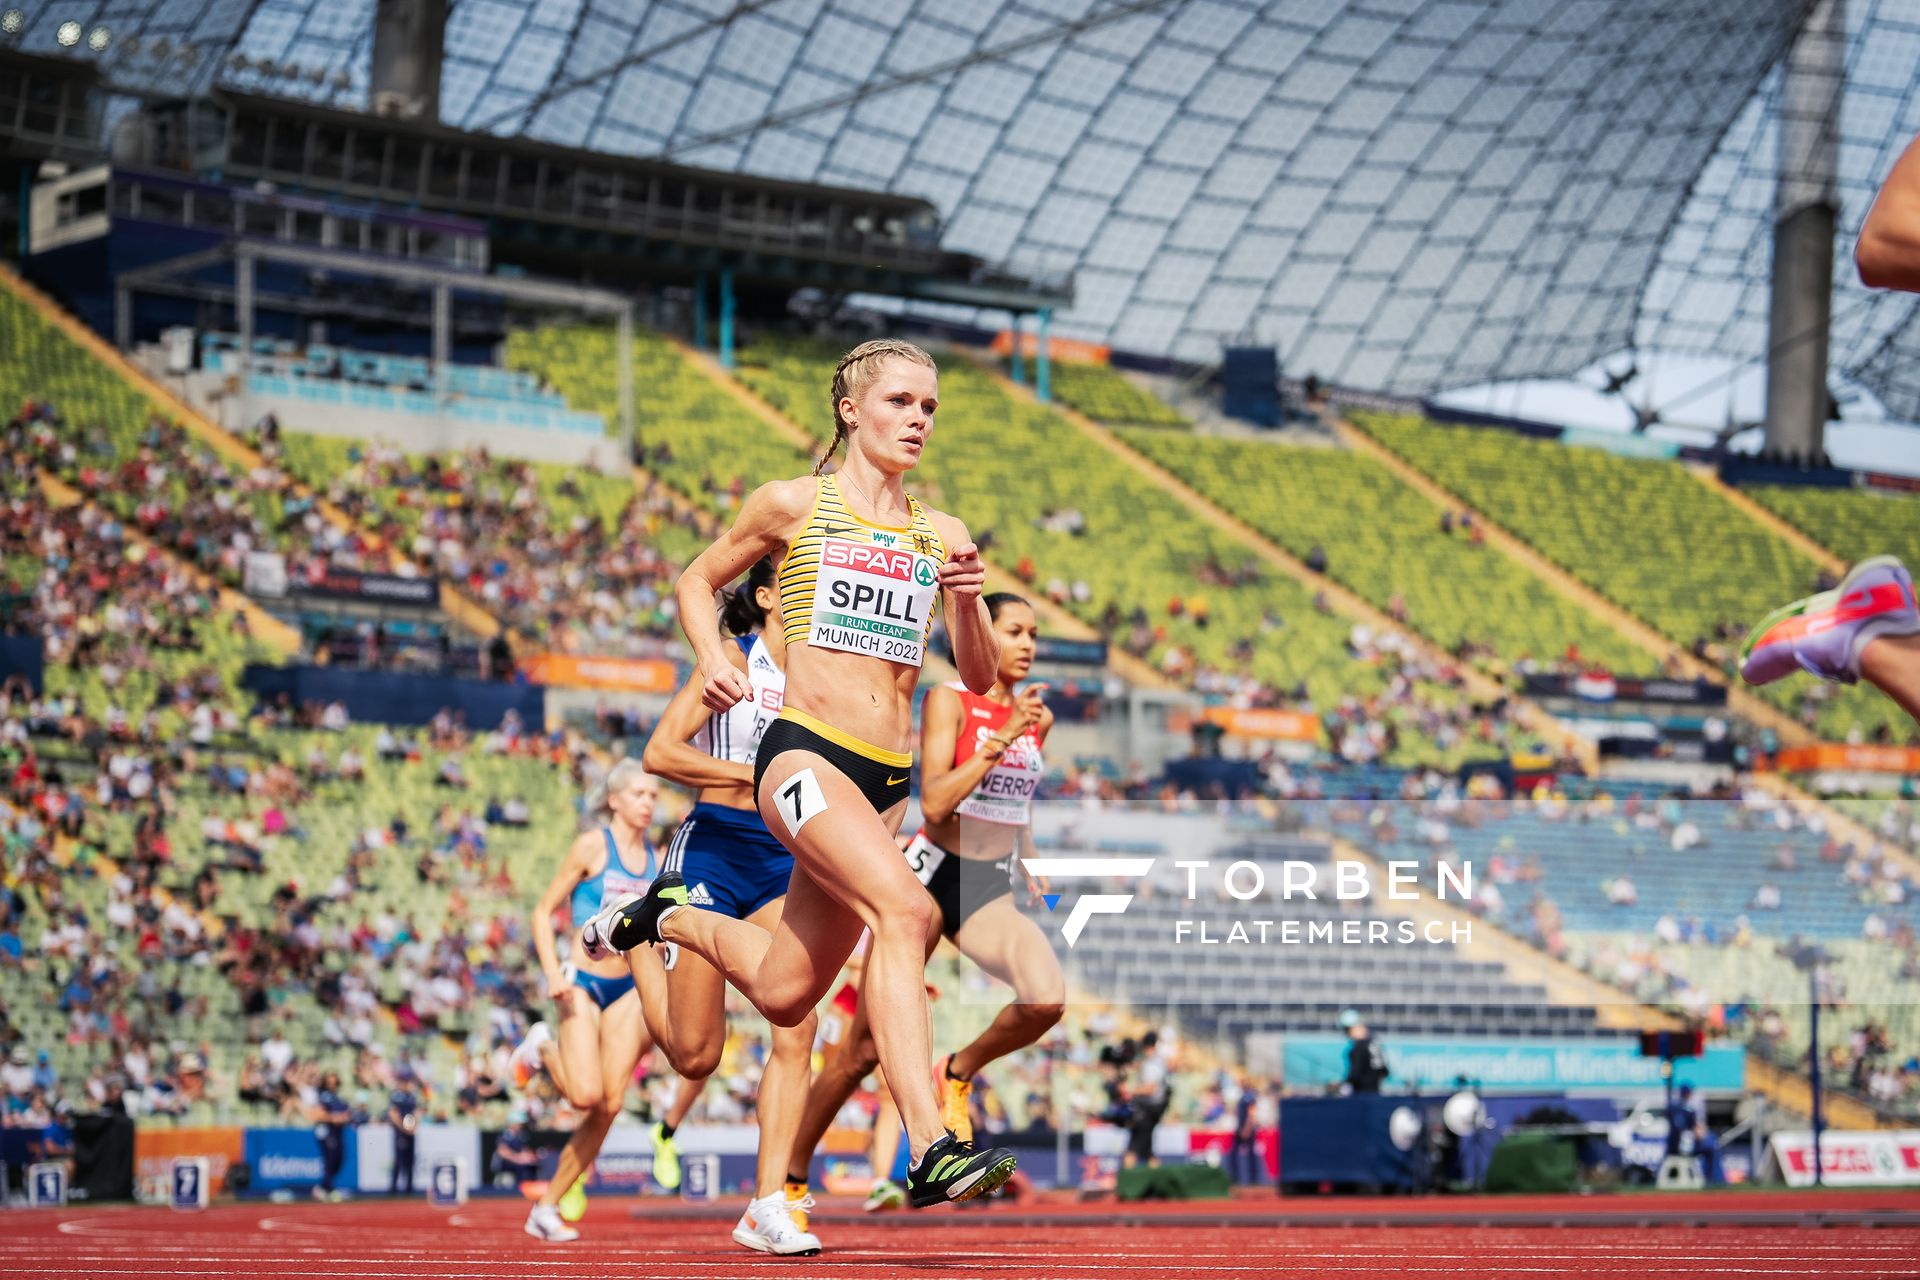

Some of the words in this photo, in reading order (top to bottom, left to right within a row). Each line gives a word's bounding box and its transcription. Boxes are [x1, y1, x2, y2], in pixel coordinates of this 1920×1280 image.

[826, 544, 912, 578] SPAR
[829, 580, 918, 624] SPILL
[846, 617, 869, 629] RUN
[816, 627, 880, 652] MUNICH
[884, 640, 918, 660] 2022
[783, 780, 802, 822] 7
[912, 849, 931, 872] 5
